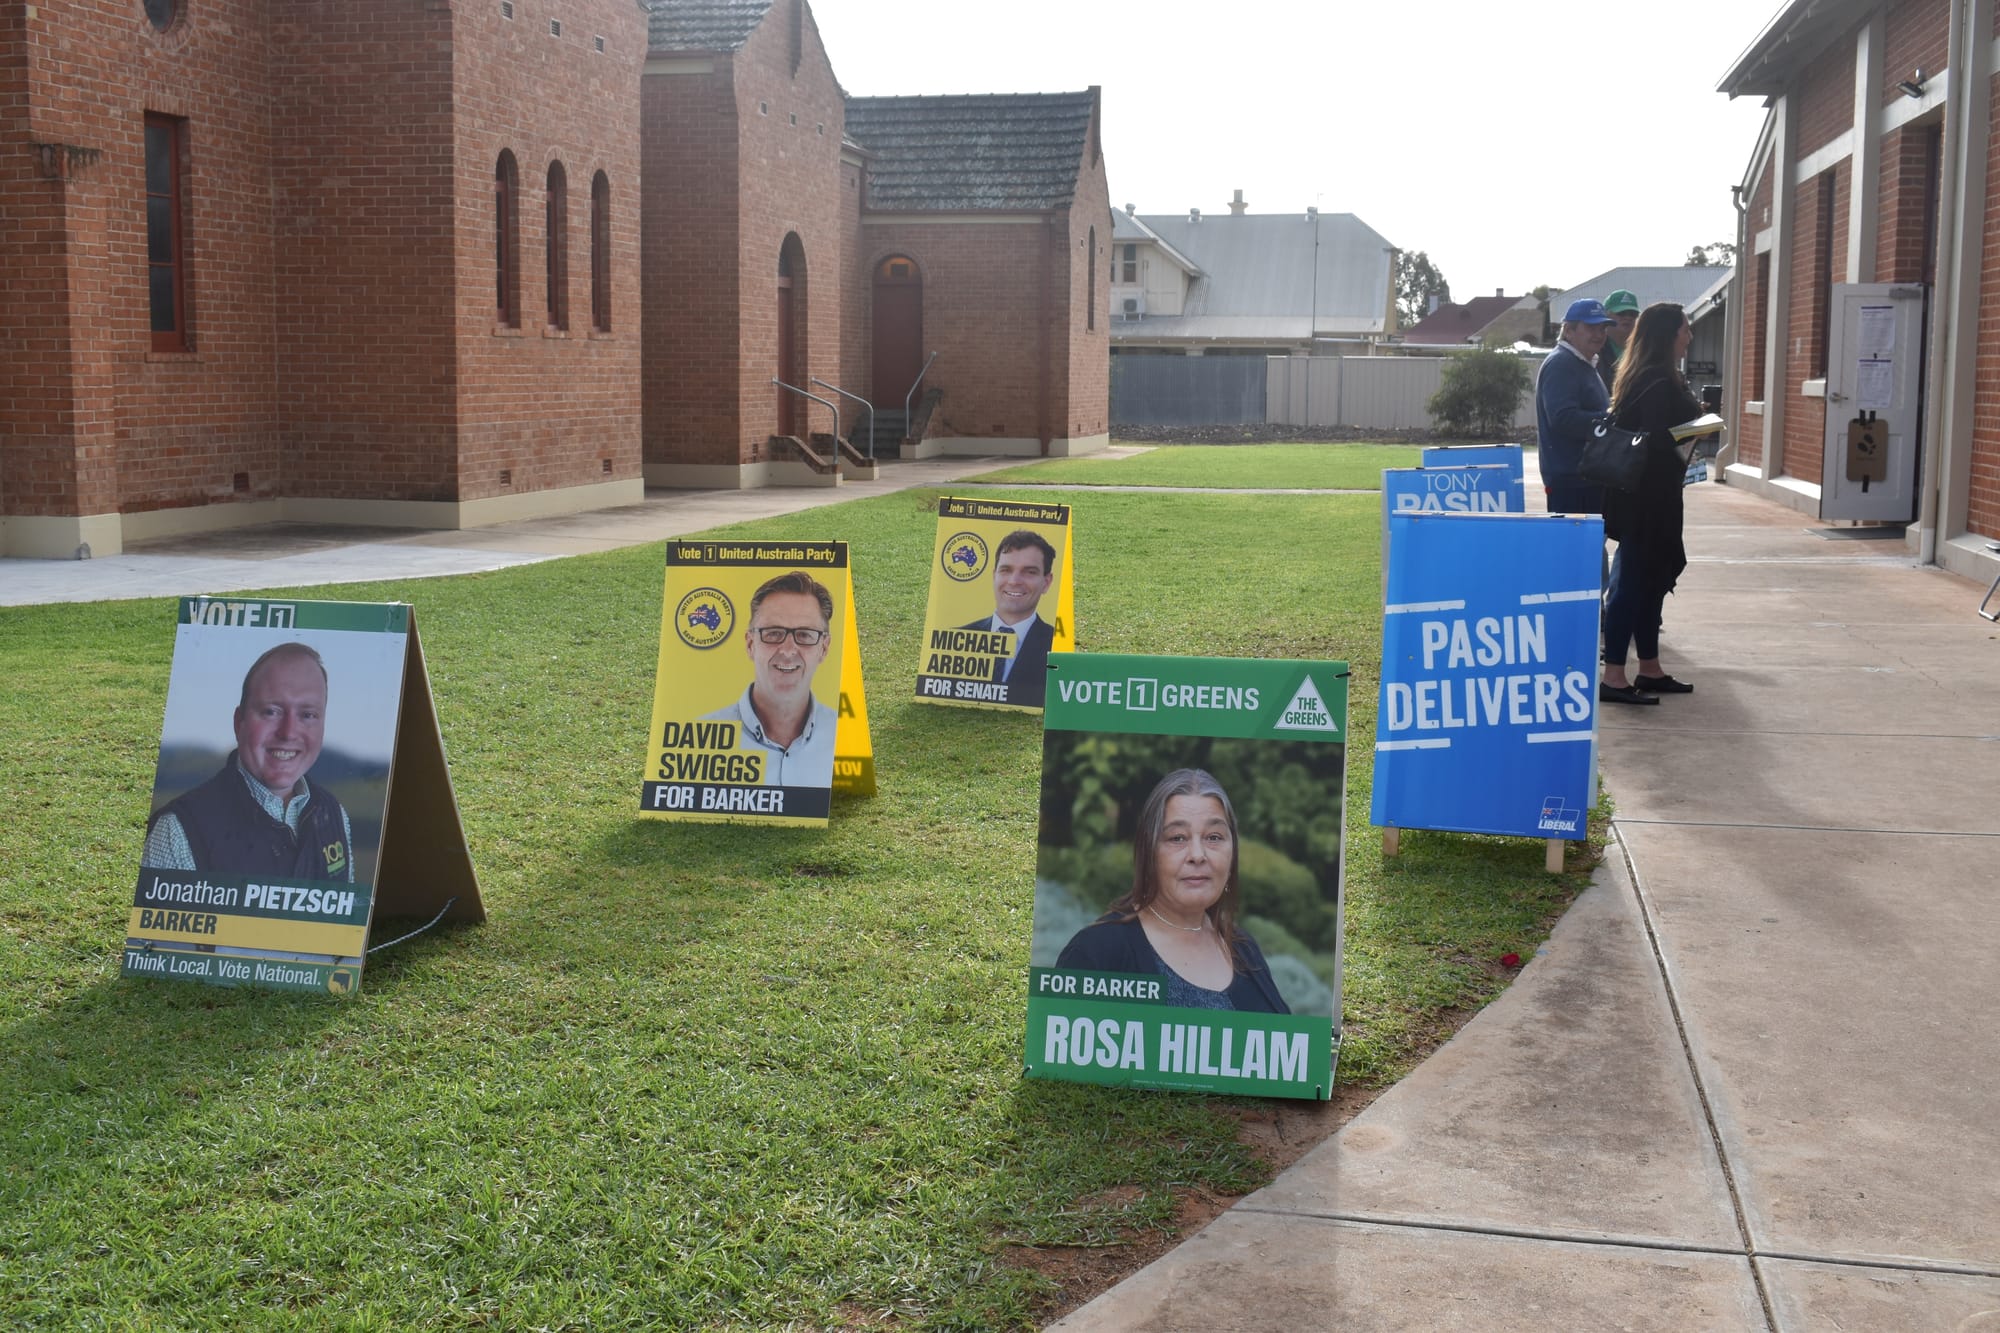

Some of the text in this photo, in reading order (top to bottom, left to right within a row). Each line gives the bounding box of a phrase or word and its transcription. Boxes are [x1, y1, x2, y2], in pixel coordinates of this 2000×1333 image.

[1422, 473, 1482, 491] TONY
[978, 505, 1002, 515] United
[1003, 507, 1039, 519] Australia
[1040, 509, 1062, 522] Party
[1397, 491, 1506, 513] PASIN
[719, 547, 752, 560] United
[755, 547, 804, 561] Australia
[806, 548, 836, 564] Party
[693, 591, 722, 601] AUSTRALIA
[189, 601, 262, 627] VOTE
[930, 630, 1010, 655] MICHAEL
[1422, 614, 1547, 670] PASIN
[926, 653, 991, 678] ARBON
[923, 678, 1009, 702] FOR SENATE
[1058, 680, 1122, 705] VOTE
[1161, 684, 1260, 711] GREENS
[1386, 671, 1591, 731] DELIVERS
[1297, 697, 1318, 711] THE
[1284, 711, 1328, 726] GREENS
[662, 722, 736, 750] DAVID
[658, 752, 761, 783] SWIGGS
[653, 785, 784, 813] FOR BARKER
[1537, 818, 1577, 831] LIBERAL
[145, 876, 355, 916] Jonathan PIETZSCH
[139, 909, 218, 935] BARKER
[127, 952, 322, 986] Think Local. Vote National.
[1039, 973, 1161, 1000] FOR BARKER
[1044, 1014, 1310, 1083] ROSA HILLAM
